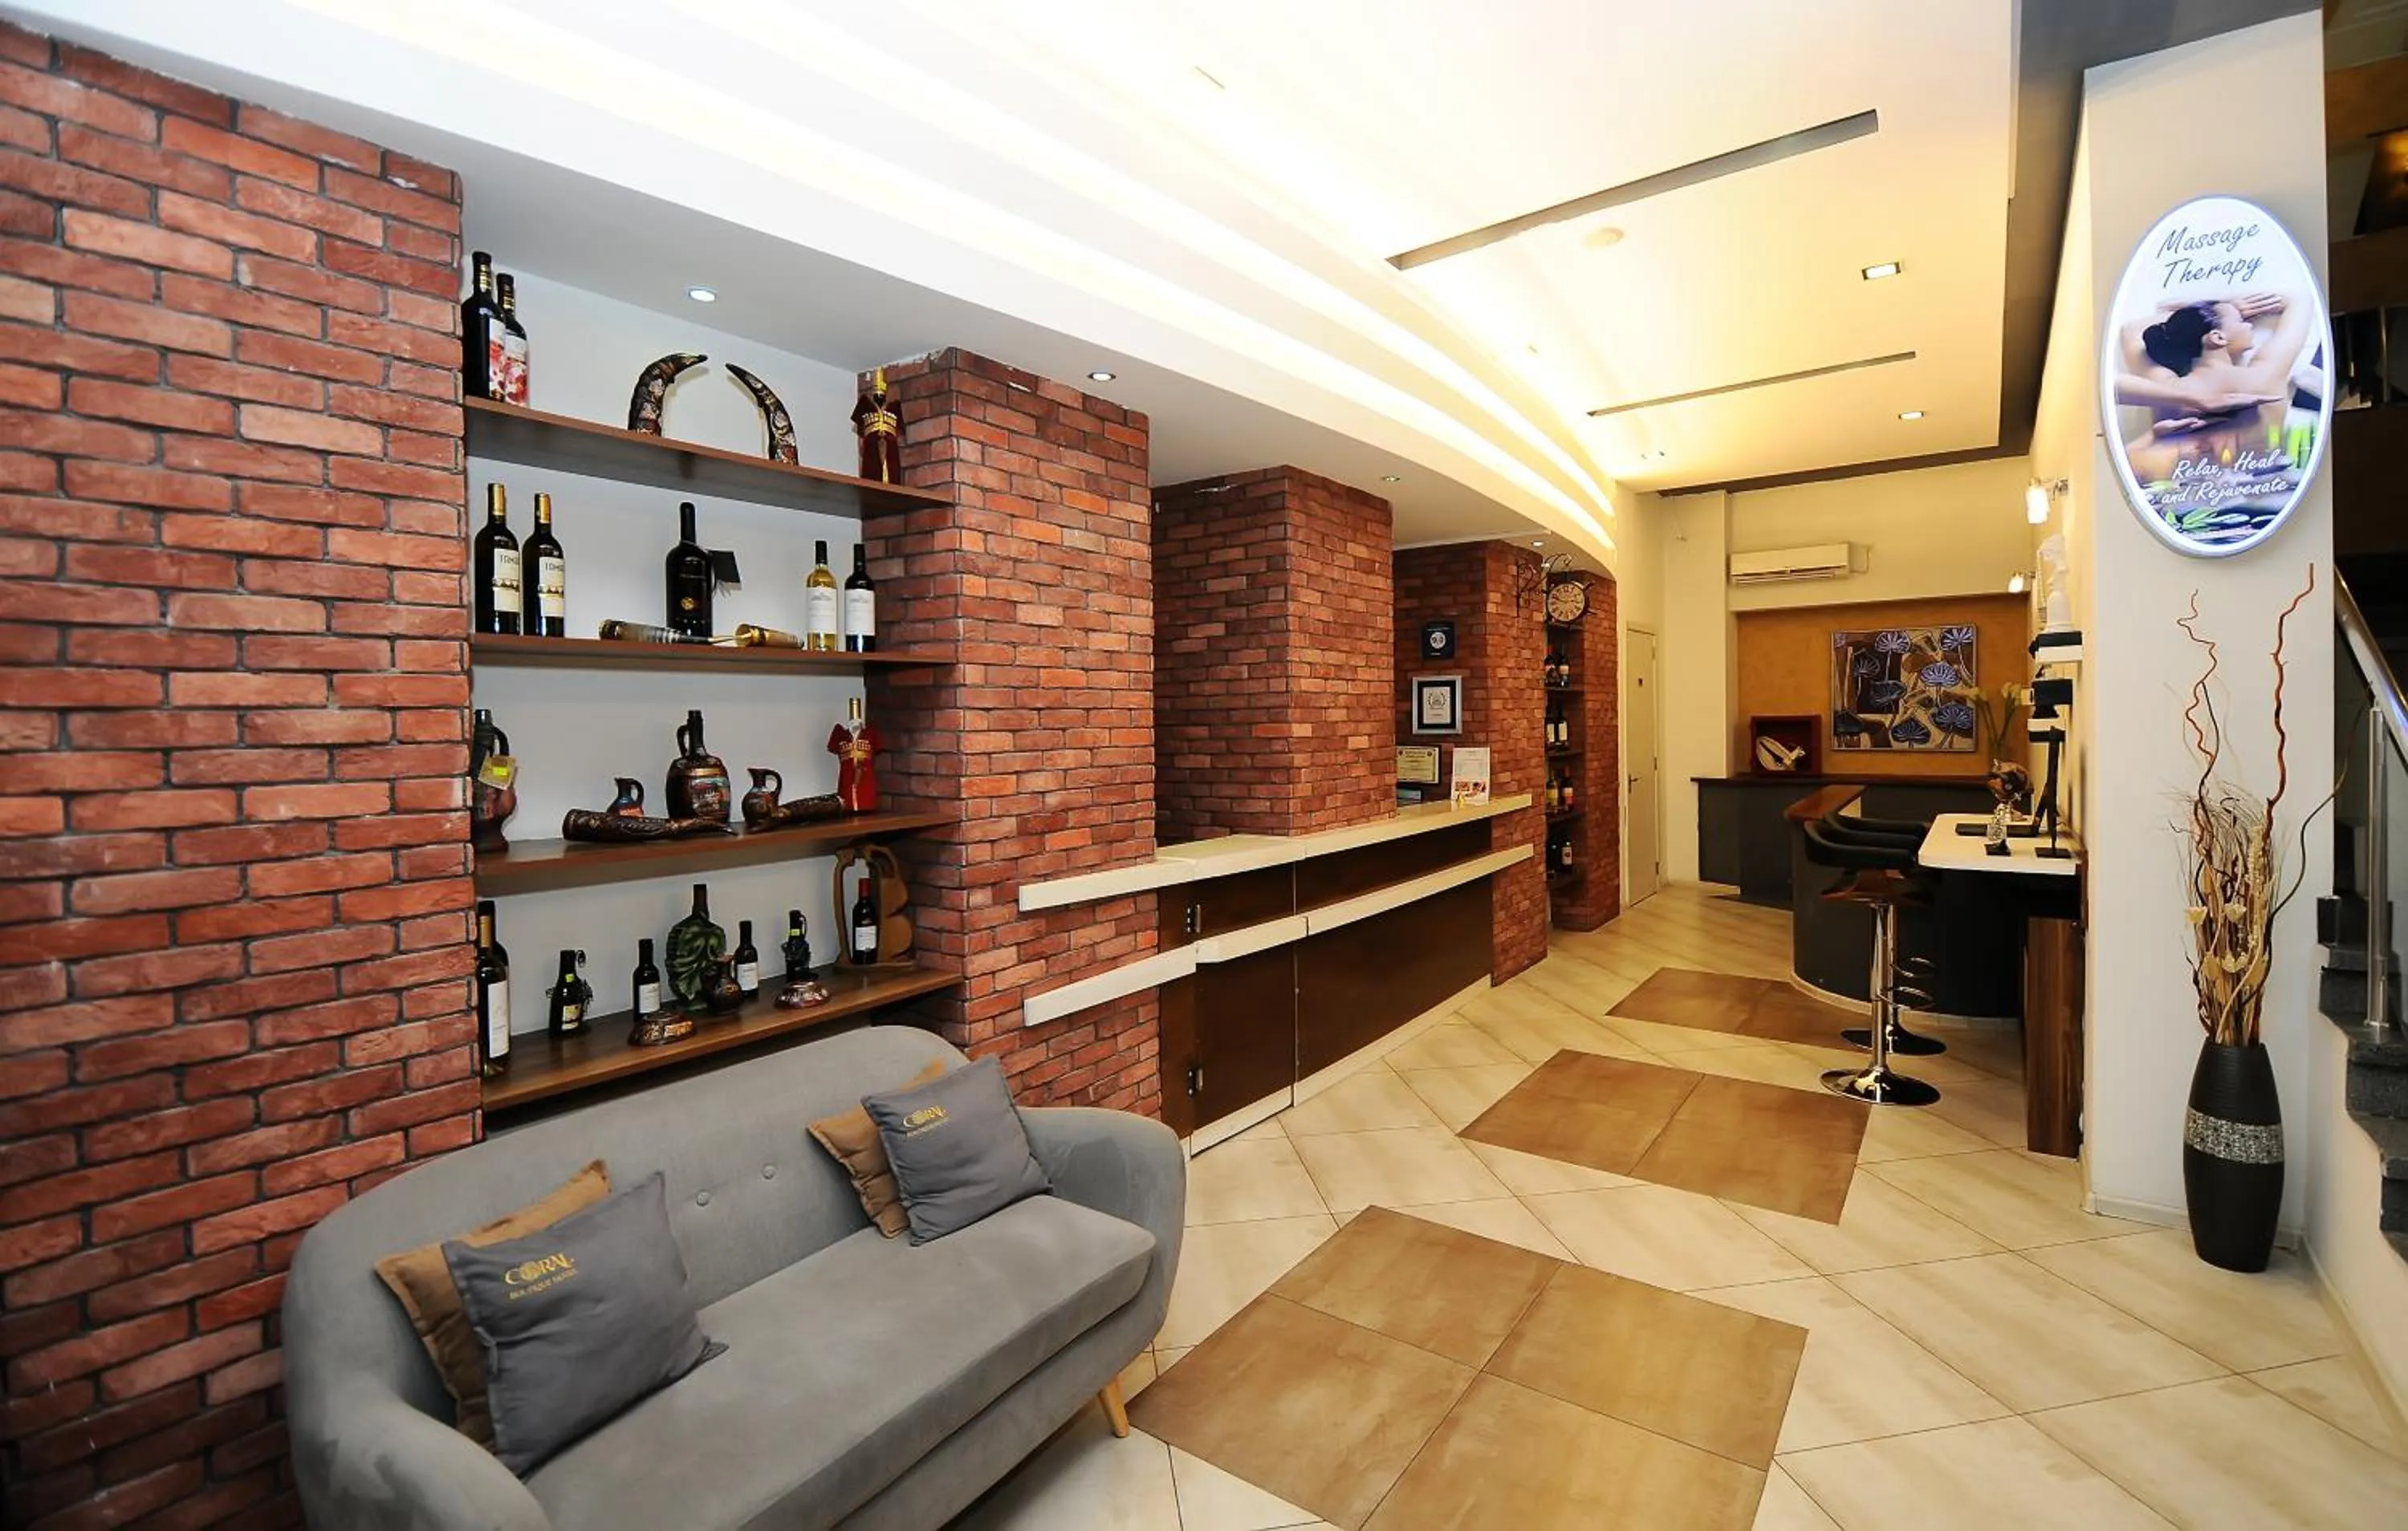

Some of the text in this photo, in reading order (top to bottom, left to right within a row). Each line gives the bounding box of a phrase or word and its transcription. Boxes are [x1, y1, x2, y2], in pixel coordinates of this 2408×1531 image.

[2156, 224, 2260, 258] Massage
[2163, 256, 2263, 288] Therapy
[2171, 449, 2280, 480] Relax, Heal
[2162, 485, 2190, 503] and
